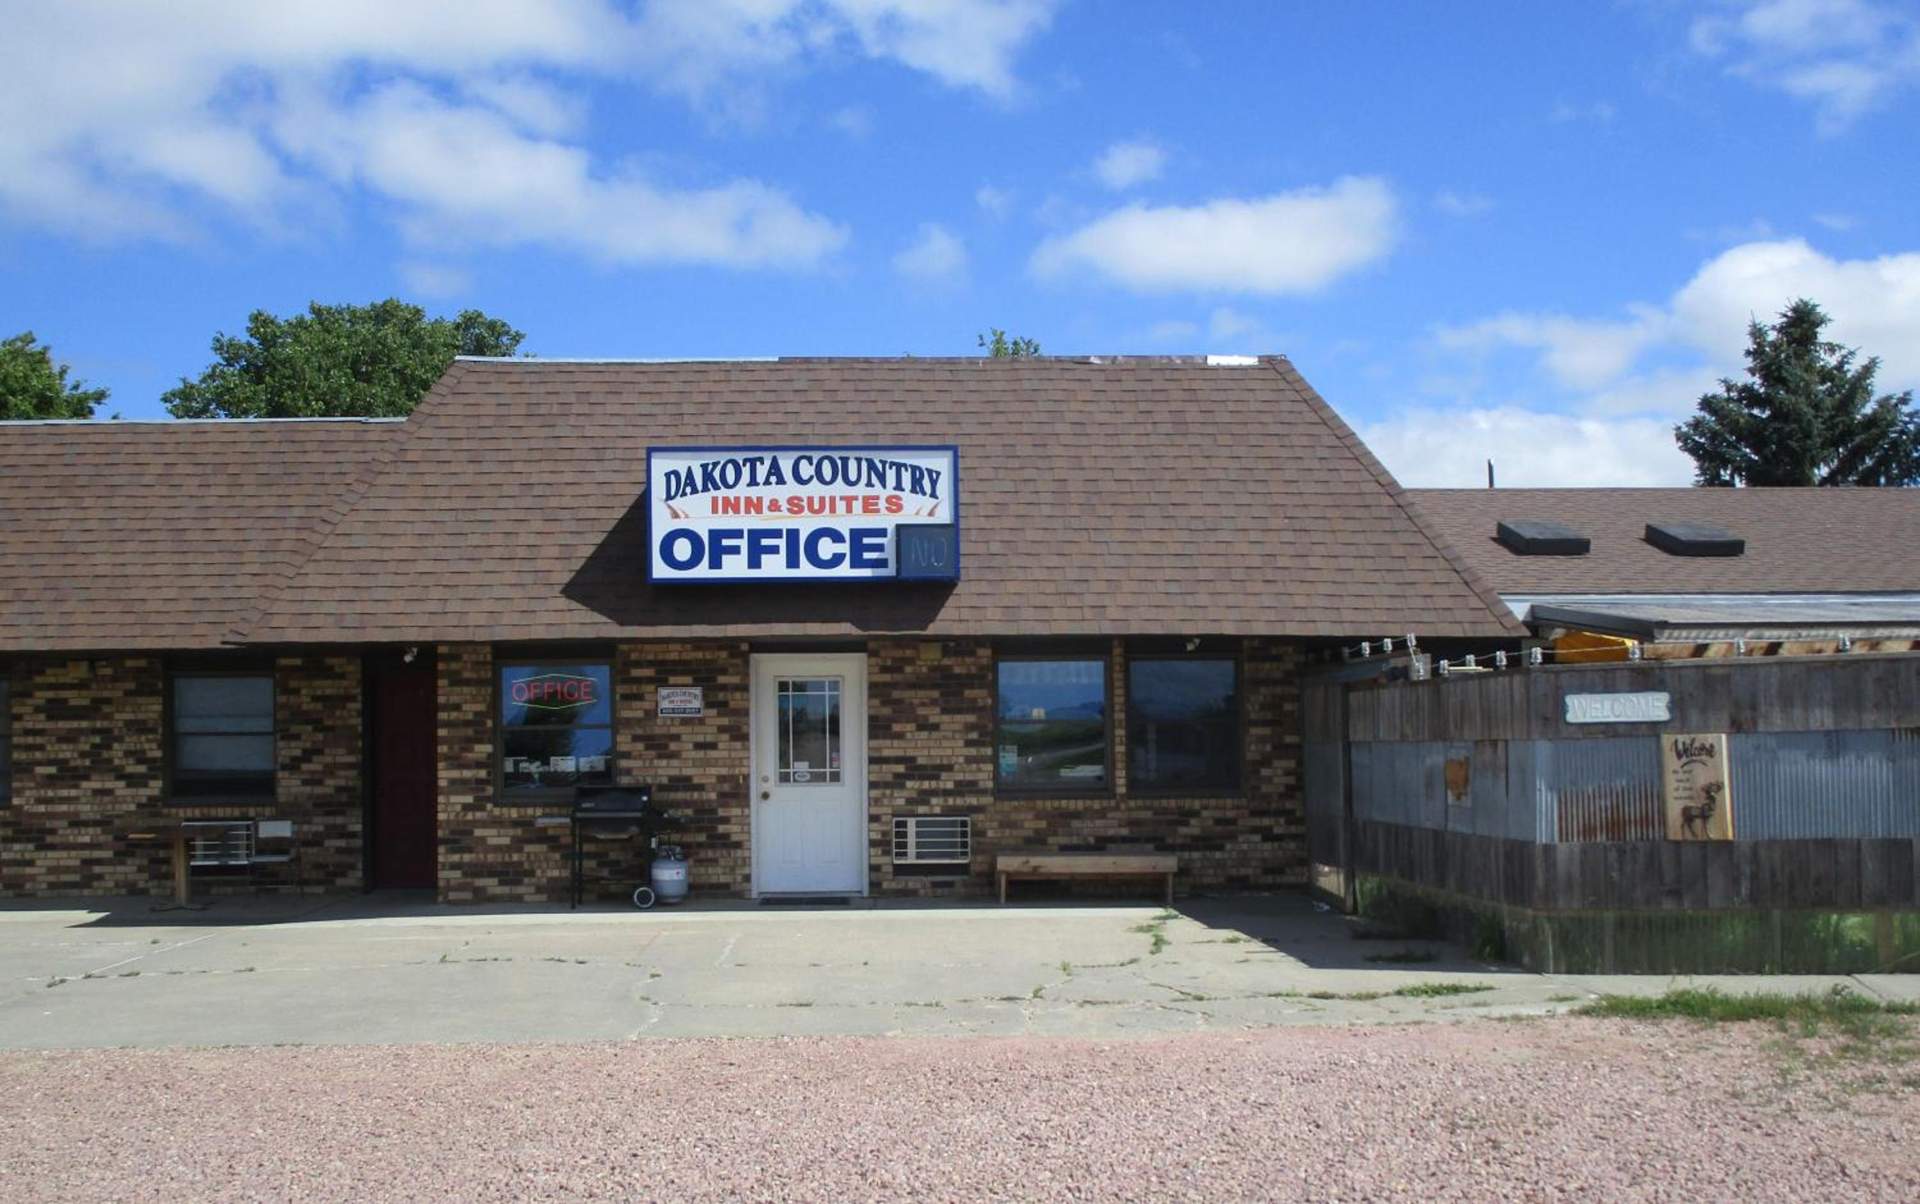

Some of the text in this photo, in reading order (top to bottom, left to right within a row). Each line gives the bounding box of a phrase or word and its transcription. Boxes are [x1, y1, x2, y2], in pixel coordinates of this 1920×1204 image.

[664, 455, 942, 501] DAKOTA COUNTRY
[659, 527, 889, 571] OFFICE
[512, 681, 593, 702] OFFICE
[1573, 696, 1666, 720] WELCOME
